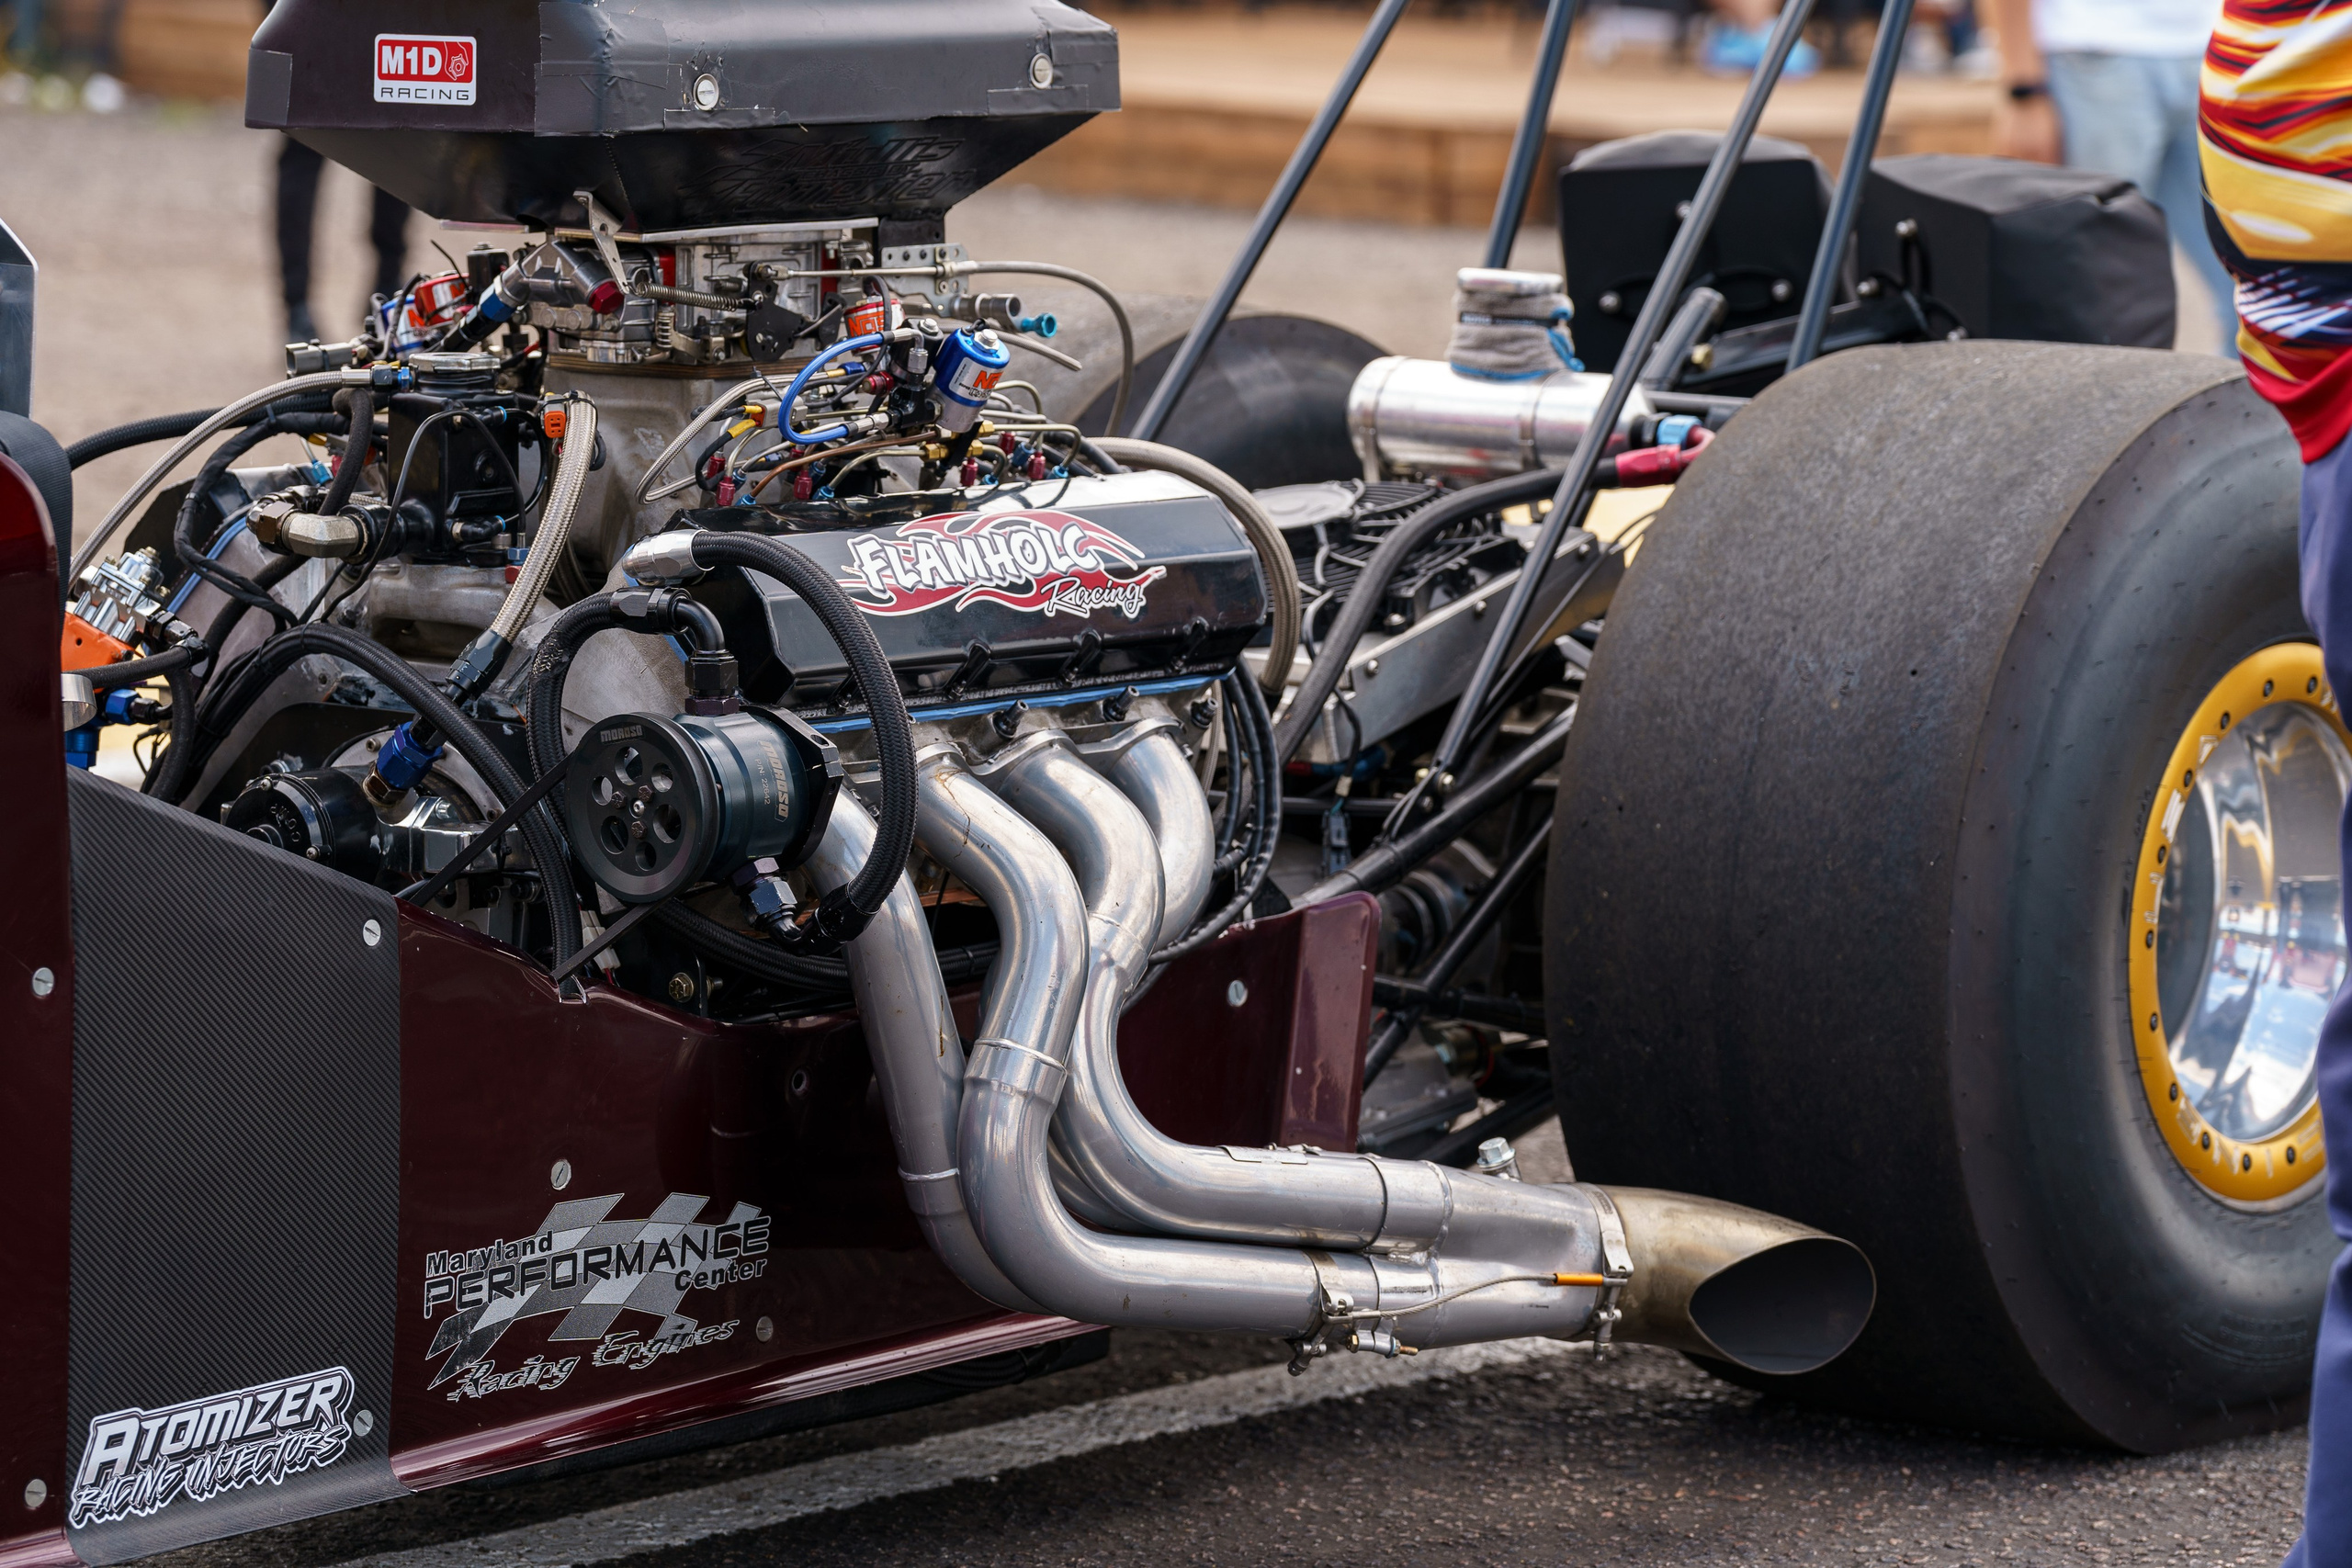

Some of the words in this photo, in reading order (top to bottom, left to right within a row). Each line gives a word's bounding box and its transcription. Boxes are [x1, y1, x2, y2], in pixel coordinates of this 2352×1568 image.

[381, 45, 442, 75] M1D
[381, 87, 469, 100] RACING
[854, 524, 1099, 593] FLAMHOLC
[1040, 576, 1144, 616] Racing
[600, 725, 643, 742] MOROSO
[758, 740, 788, 818] MOROSO
[762, 778, 771, 805] 22642
[424, 1216, 771, 1319] PERFORMANCE
[426, 1231, 553, 1278] Maryland
[673, 1256, 767, 1292] Center
[447, 1356, 581, 1402] Racing
[593, 1320, 741, 1370] Engines
[82, 1372, 349, 1488] ATOMIZER
[74, 1456, 184, 1522] RACING
[186, 1423, 349, 1495] INJECTORS
